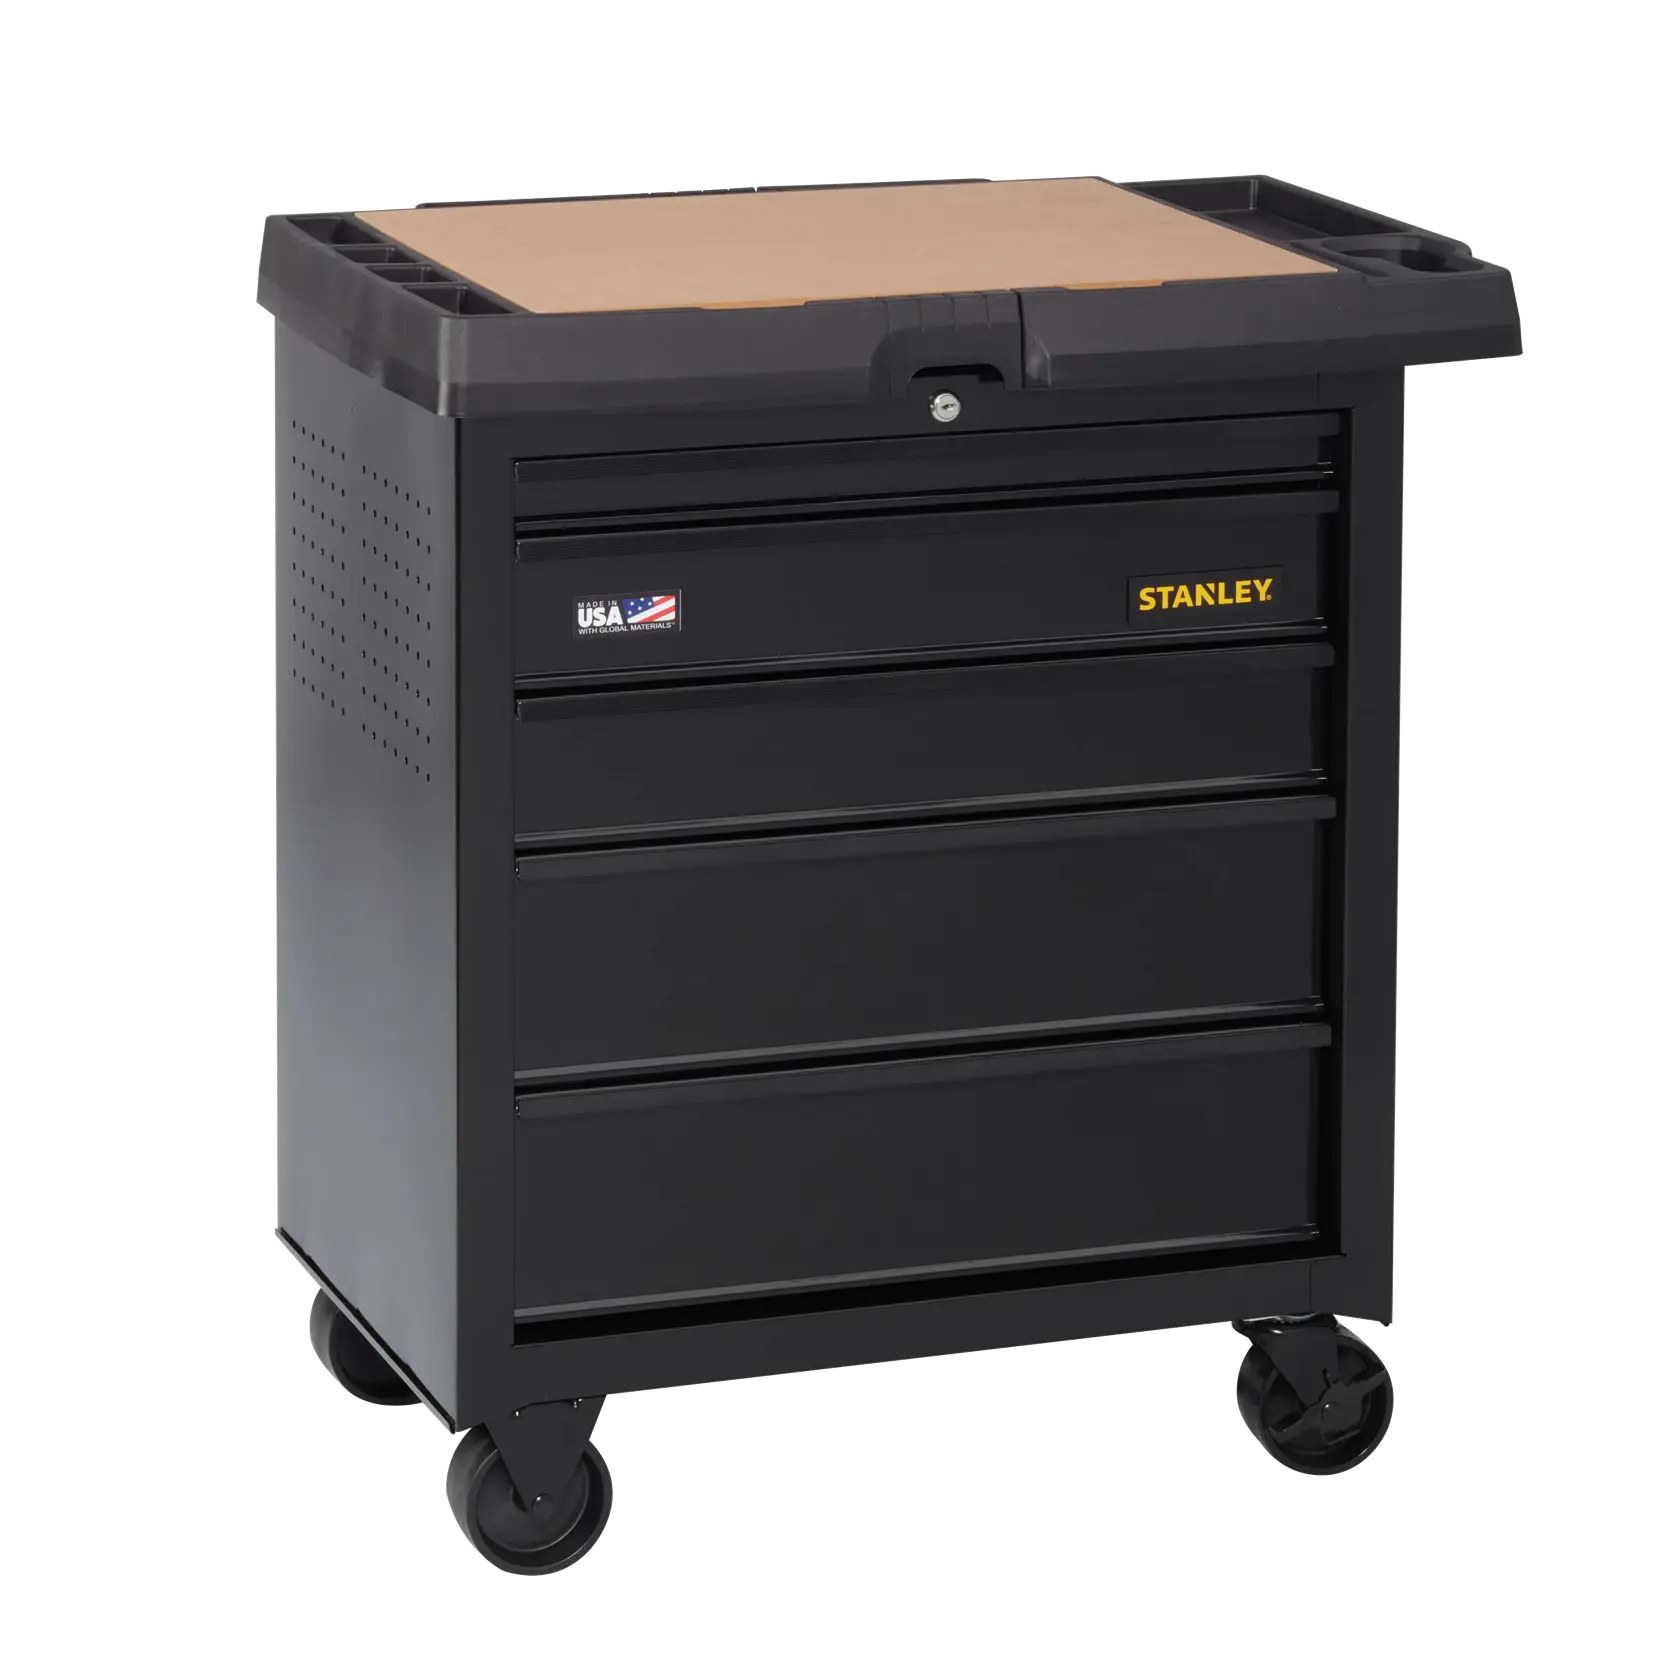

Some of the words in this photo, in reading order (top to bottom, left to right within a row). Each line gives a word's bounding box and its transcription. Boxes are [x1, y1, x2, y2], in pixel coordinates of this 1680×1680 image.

[577, 601, 604, 609] MADE
[577, 605, 624, 628] USA
[578, 627, 598, 635] WITH
[599, 625, 629, 634] GLOBAL
